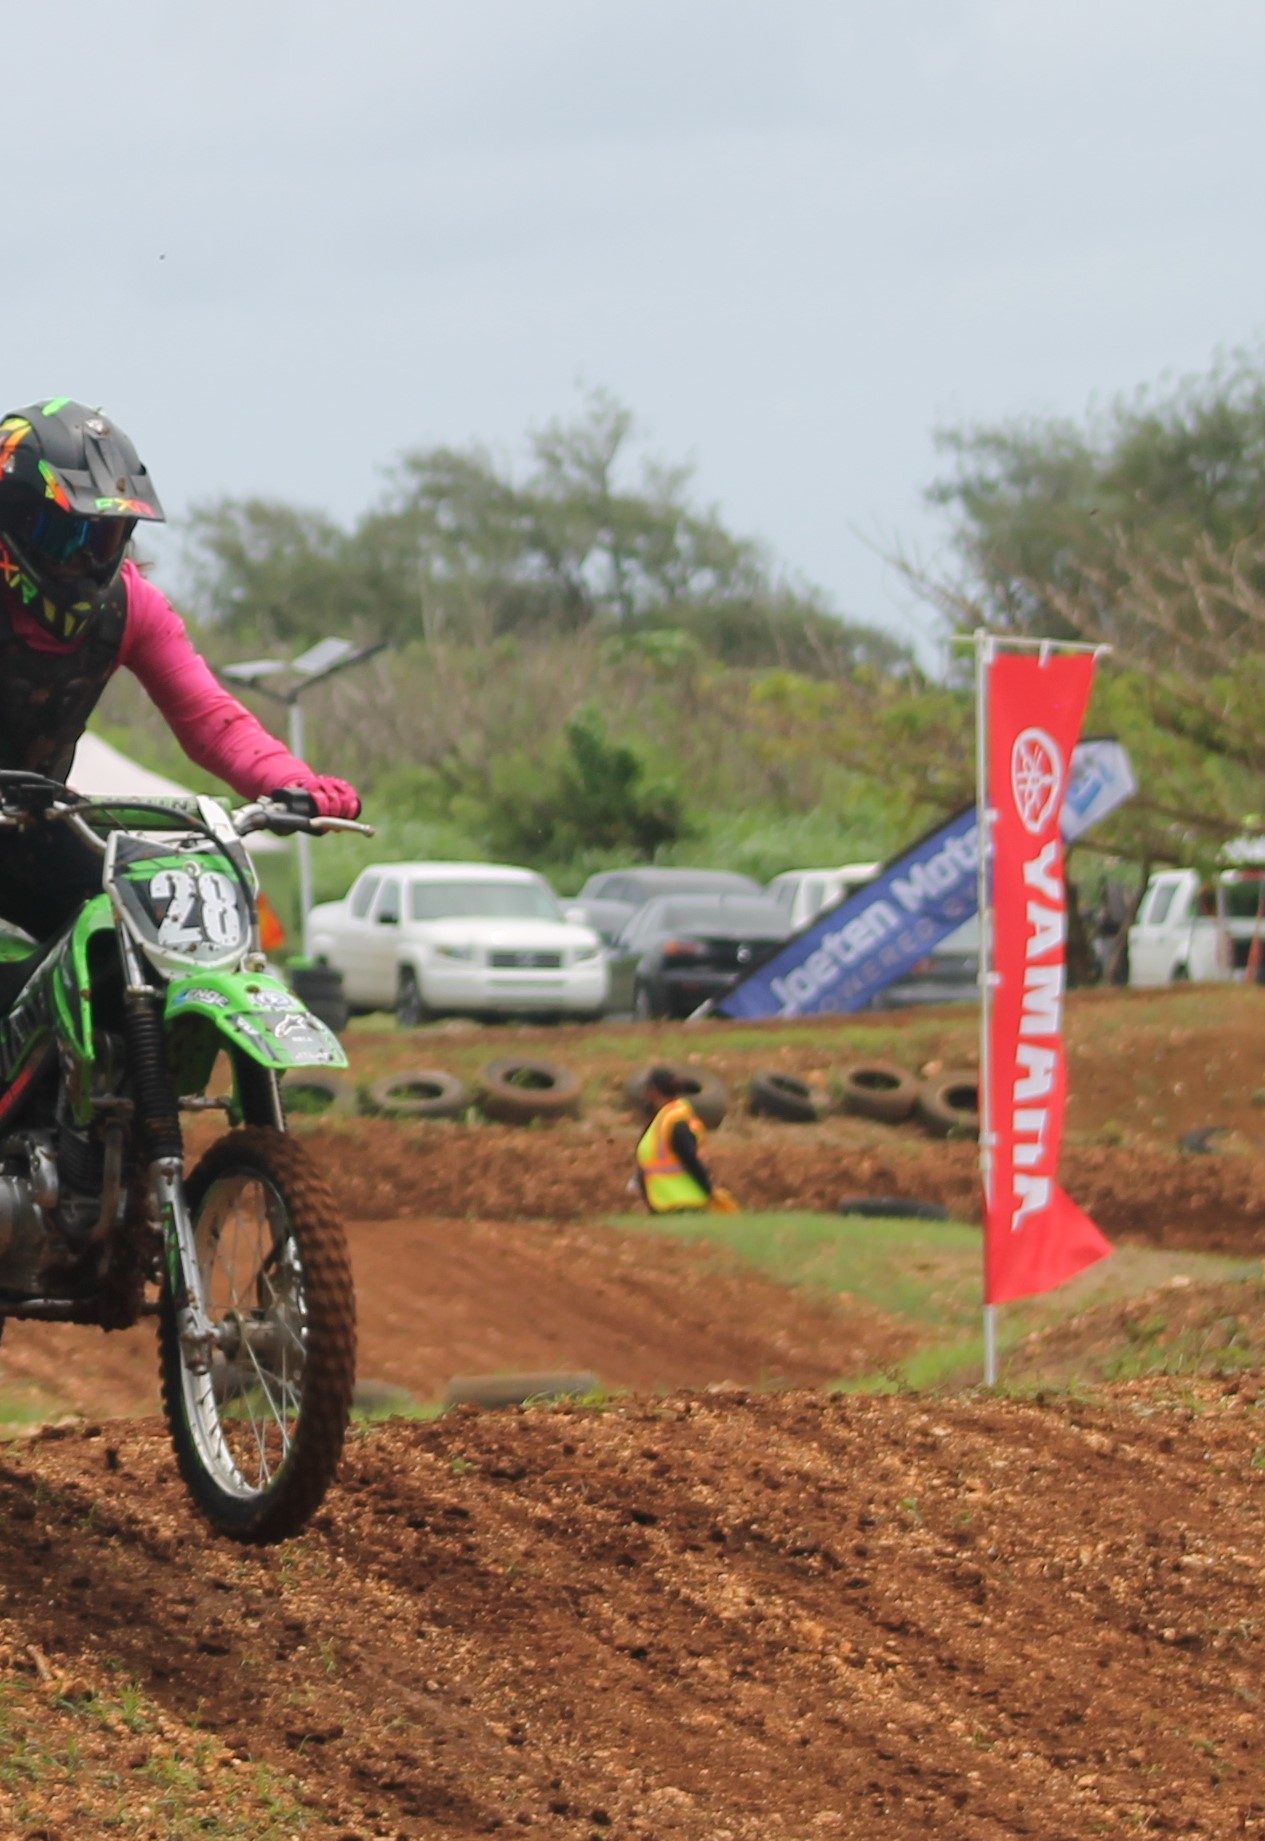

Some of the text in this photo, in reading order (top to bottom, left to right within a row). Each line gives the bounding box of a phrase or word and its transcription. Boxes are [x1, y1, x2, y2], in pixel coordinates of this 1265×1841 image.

[95, 497, 156, 517] FXR
[150, 870, 240, 947] 28
[769, 824, 993, 1018] Joeten Moto
[816, 917, 935, 1015] OWERED
[1011, 840, 1065, 1232] YAMAHA
